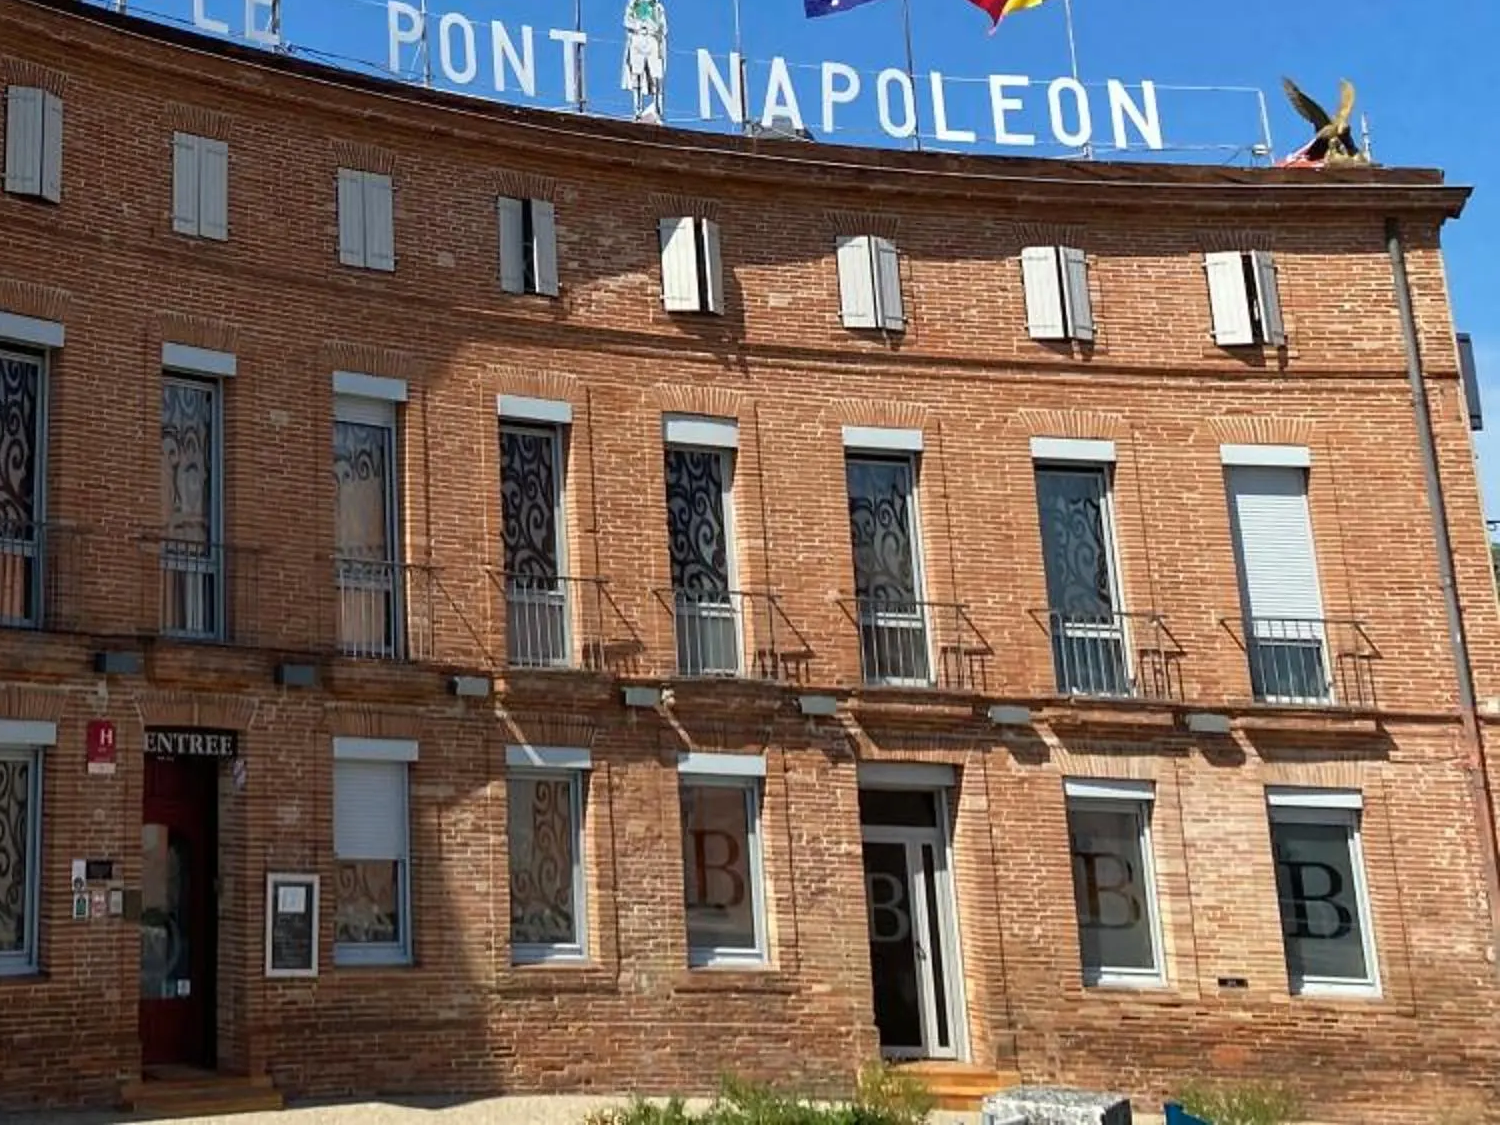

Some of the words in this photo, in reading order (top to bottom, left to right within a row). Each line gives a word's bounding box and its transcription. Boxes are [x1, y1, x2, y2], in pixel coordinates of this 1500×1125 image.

[386, 0, 588, 103] PONT
[696, 47, 1164, 150] NAPOLEON
[99, 728, 113, 745] H
[143, 732, 233, 756] ENTREE
[689, 828, 746, 907] B
[866, 872, 910, 942] B
[1074, 851, 1141, 932] B
[1278, 860, 1354, 940] B
